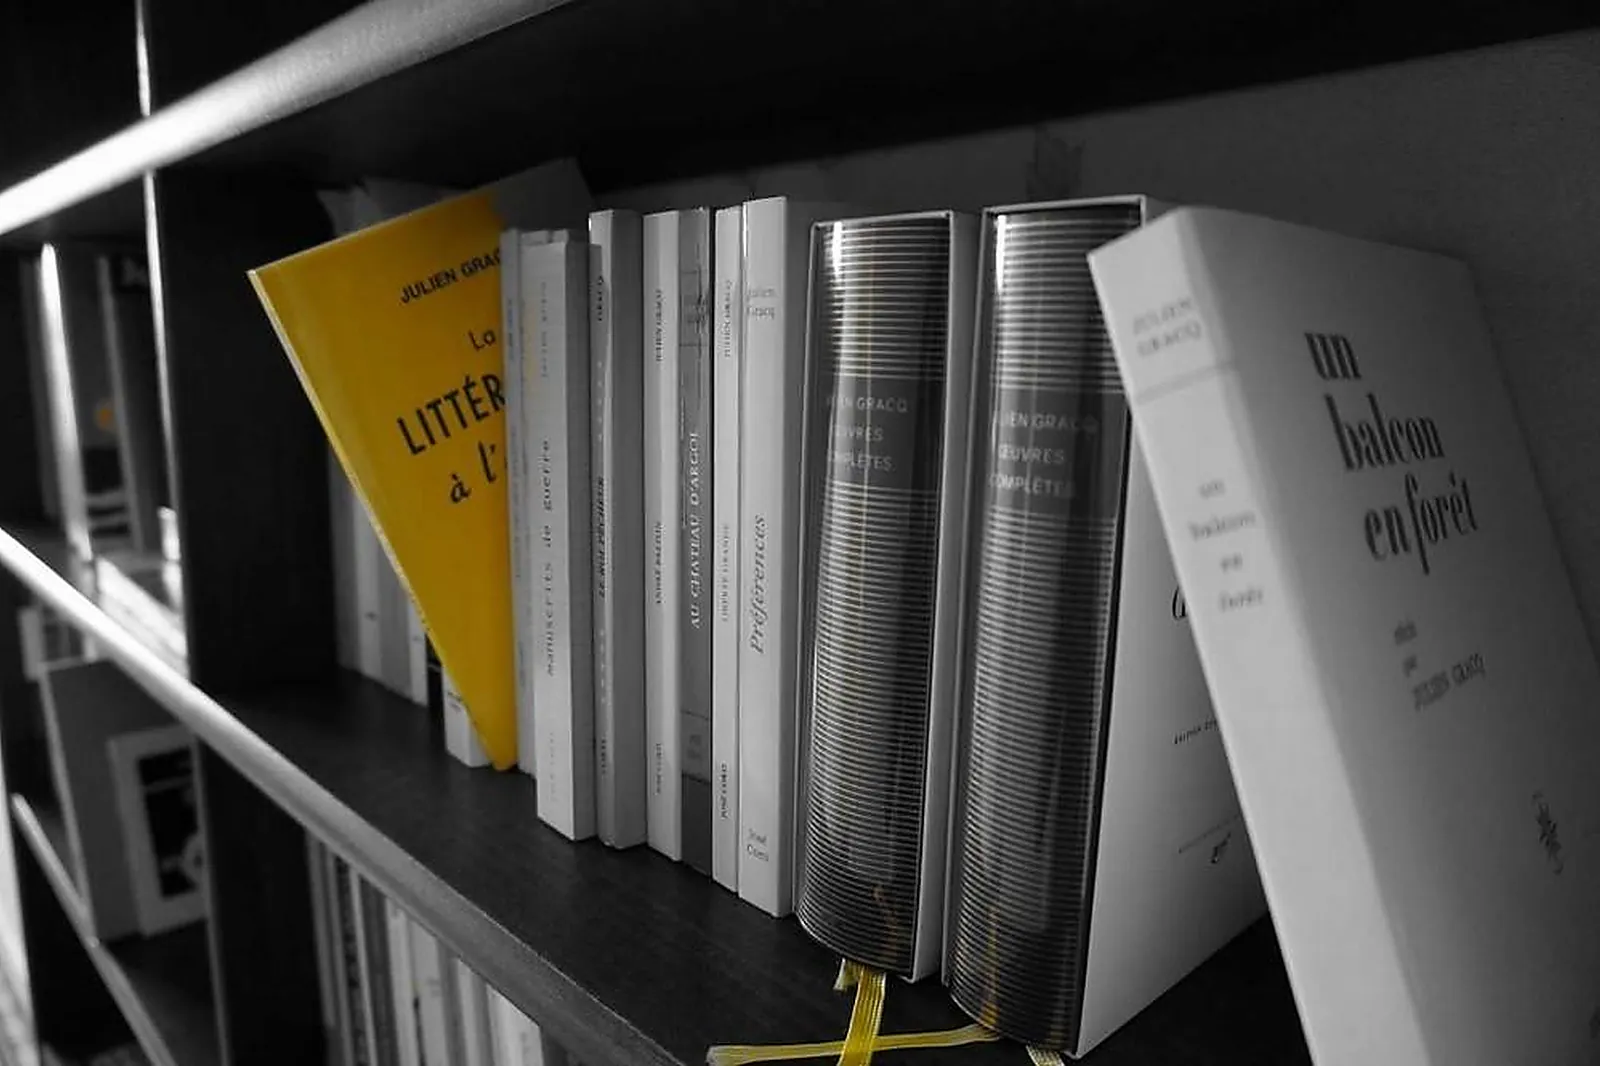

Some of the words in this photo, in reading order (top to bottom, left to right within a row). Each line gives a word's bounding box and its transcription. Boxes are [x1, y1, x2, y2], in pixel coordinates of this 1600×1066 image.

[399, 267, 457, 304] JULIEN
[723, 321, 731, 358] JULIEN
[1304, 332, 1362, 381] un
[396, 373, 506, 456] LITTÉR
[857, 396, 908, 413] GRACQ
[1323, 392, 1446, 472] balcon
[450, 472, 471, 503] à
[537, 437, 554, 511] guerre
[539, 524, 553, 548] de
[1364, 505, 1413, 561] en
[1405, 470, 1478, 576] forêt
[689, 514, 702, 598] CHATEAU
[748, 514, 767, 655] Préférences
[539, 563, 557, 677] manuscrits
[689, 604, 701, 629] AU
